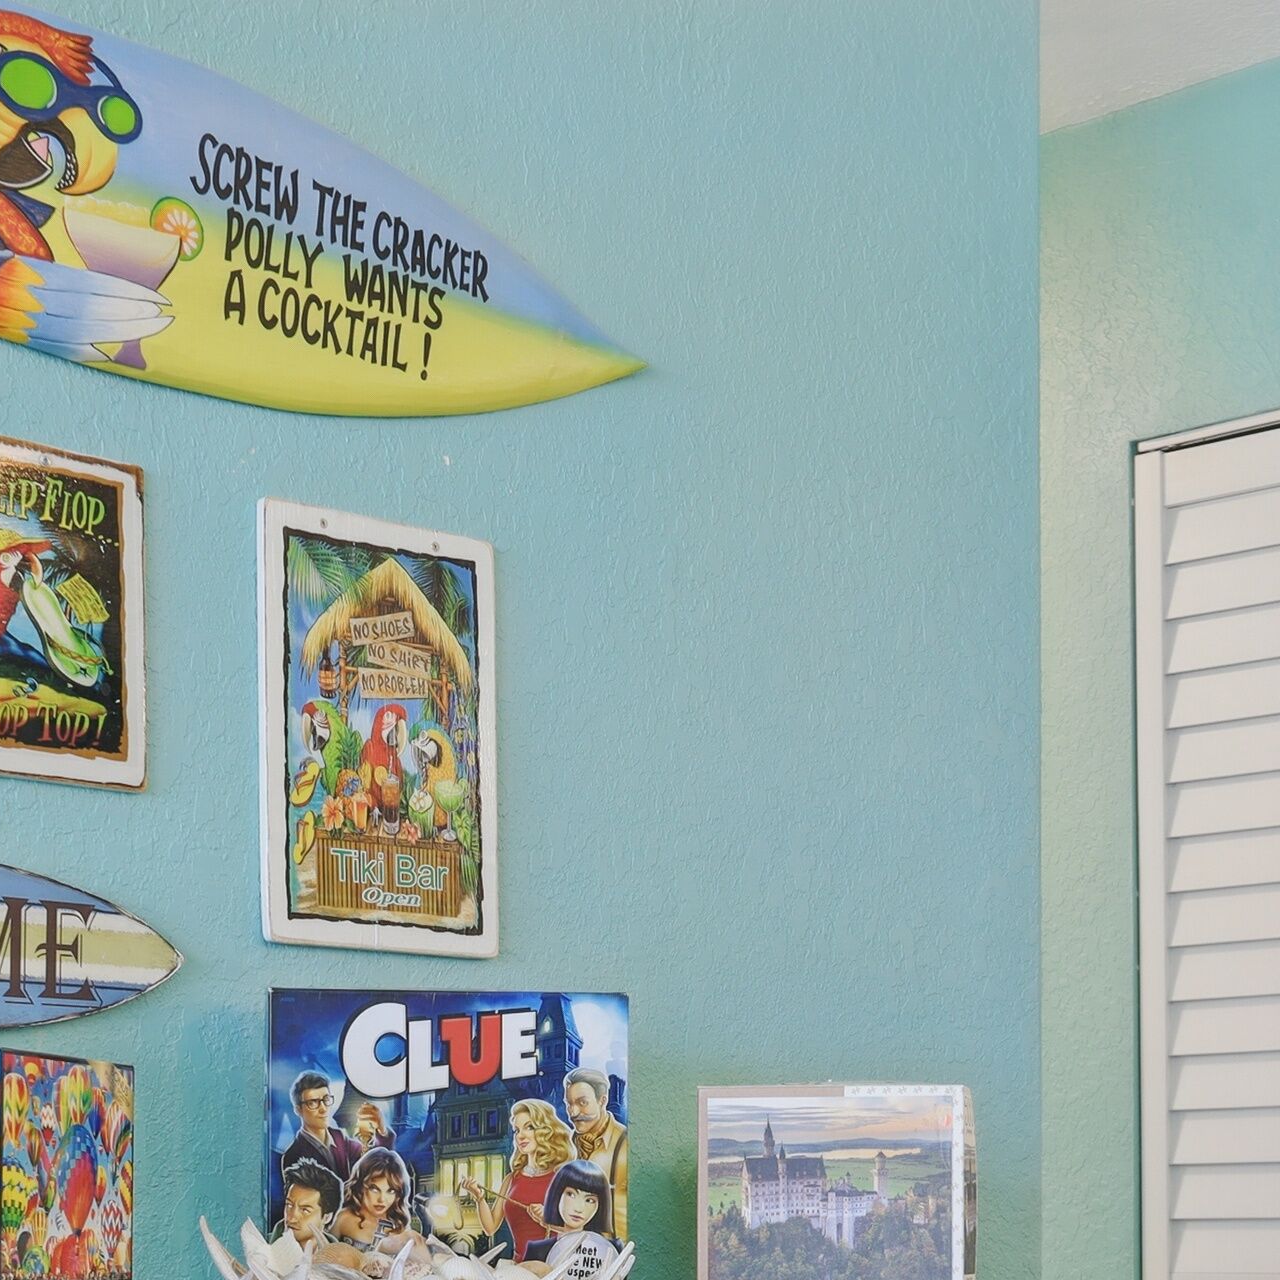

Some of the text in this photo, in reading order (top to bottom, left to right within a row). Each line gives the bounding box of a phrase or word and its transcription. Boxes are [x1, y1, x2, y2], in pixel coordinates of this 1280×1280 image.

[190, 133, 489, 303] SCREW THE CRACKER
[225, 207, 446, 330] POLLY WANTS
[224, 269, 246, 325] A
[353, 616, 412, 640] NO SHOES
[368, 644, 386, 660] NO
[361, 673, 426, 696] NO PROBLEM
[330, 847, 449, 891] Tiki Bar
[361, 886, 422, 907] Open
[342, 1001, 538, 1098] CLUE
